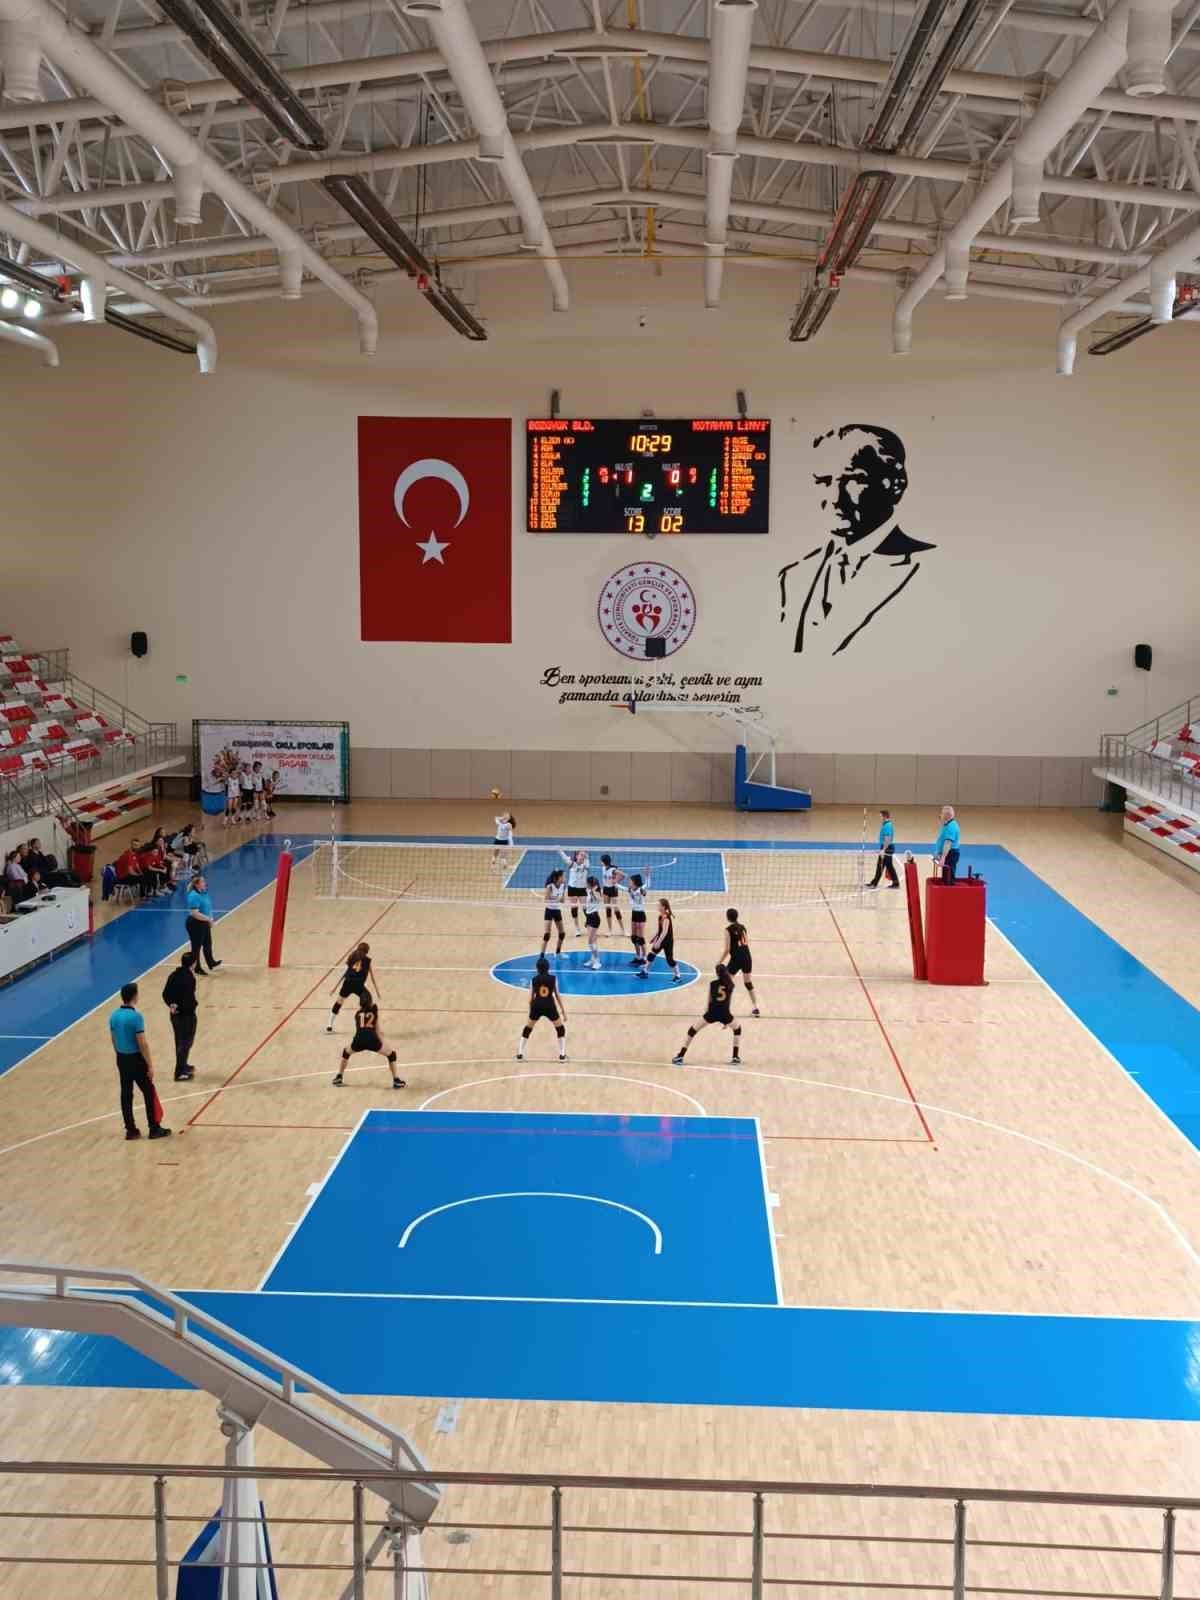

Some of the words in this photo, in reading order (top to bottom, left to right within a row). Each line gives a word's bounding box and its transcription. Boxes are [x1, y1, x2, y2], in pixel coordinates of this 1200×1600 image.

[631, 434, 672, 452] 10:29
[626, 470, 633, 483] 1
[671, 470, 680, 484] 0
[642, 483, 652, 498] 2
[628, 515, 645, 532] 13
[660, 515, 683, 532] 02
[540, 666, 575, 687] Ben
[679, 673, 714, 689] çevik
[716, 675, 732, 686] ve
[734, 675, 763, 689] aynı
[559, 690, 620, 704] zamanda
[692, 690, 741, 703] severim
[716, 985, 727, 1001] 5
[358, 1012, 376, 1028] 12
